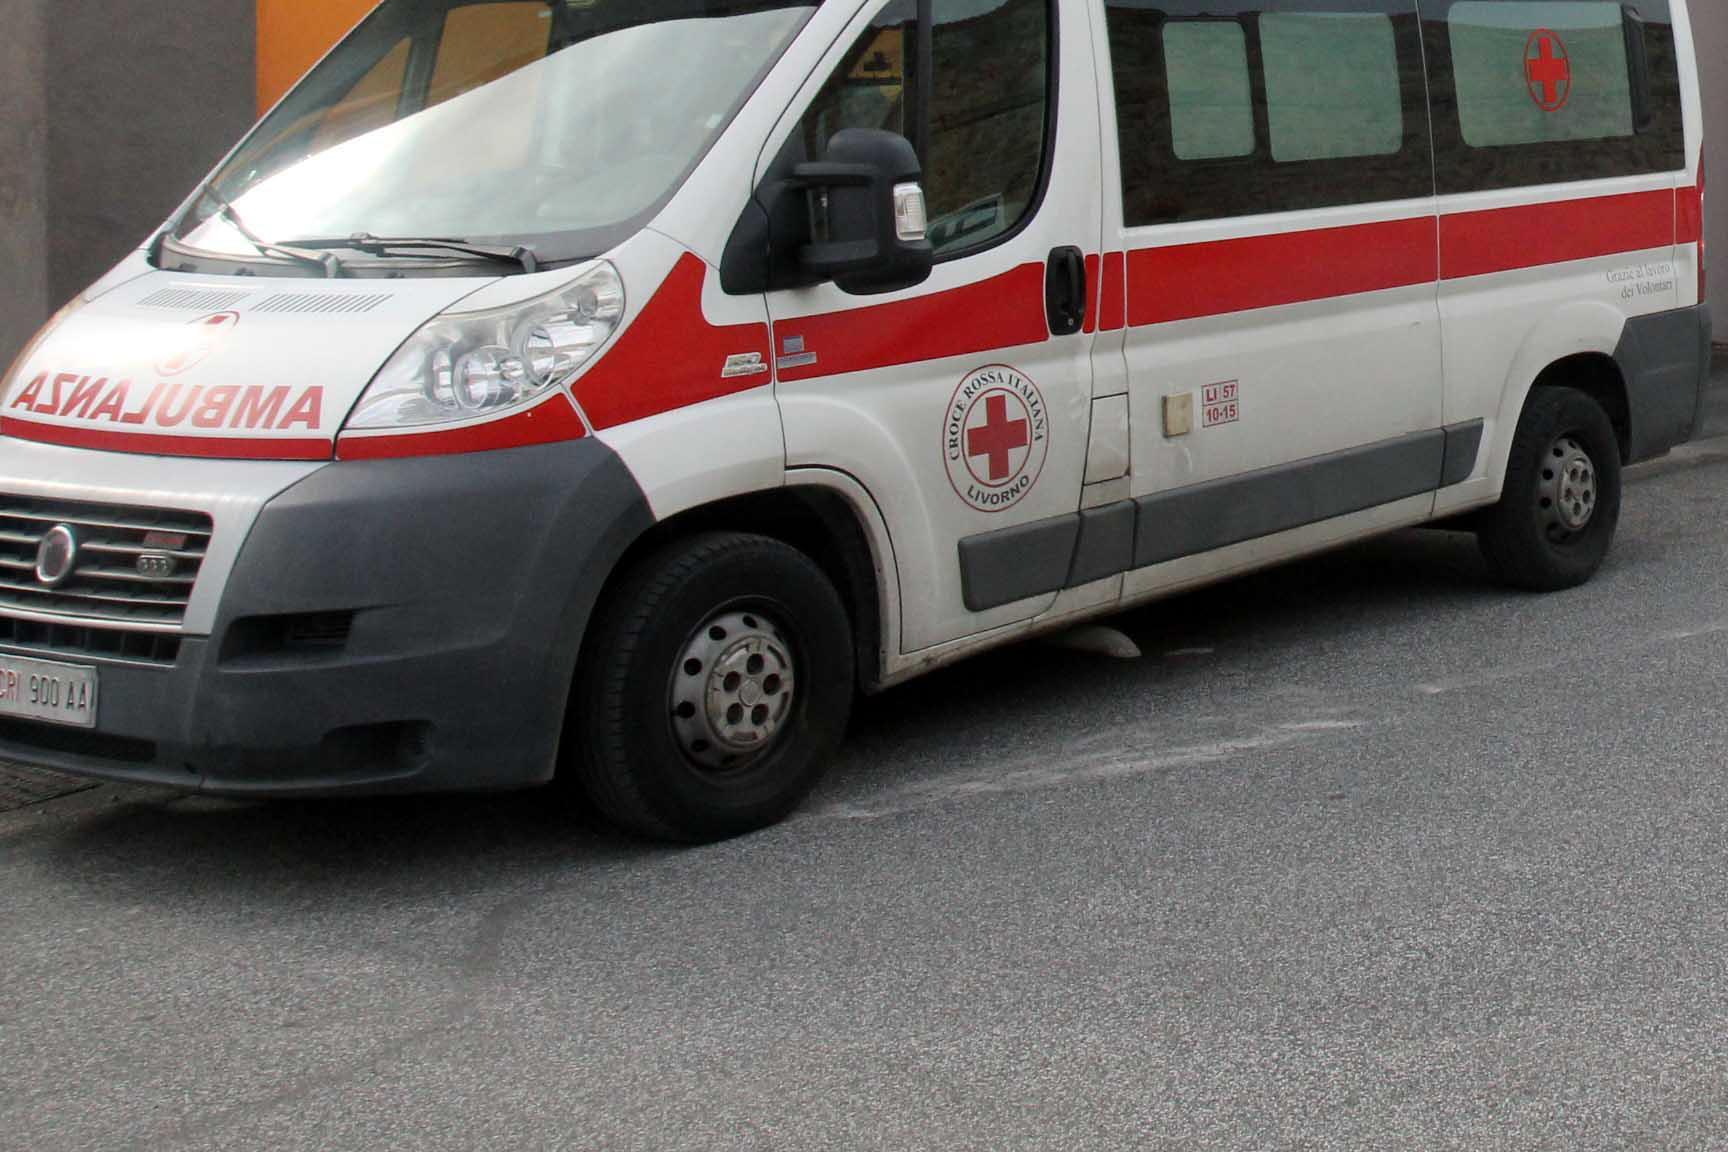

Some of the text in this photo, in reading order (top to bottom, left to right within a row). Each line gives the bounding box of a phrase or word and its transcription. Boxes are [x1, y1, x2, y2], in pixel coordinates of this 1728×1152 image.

[1206, 384, 1236, 401] LI 57
[949, 371, 1044, 461] CROCE ROSSA ITALIANA
[967, 474, 1030, 505] LIVORNO
[31, 673, 60, 707] 900
